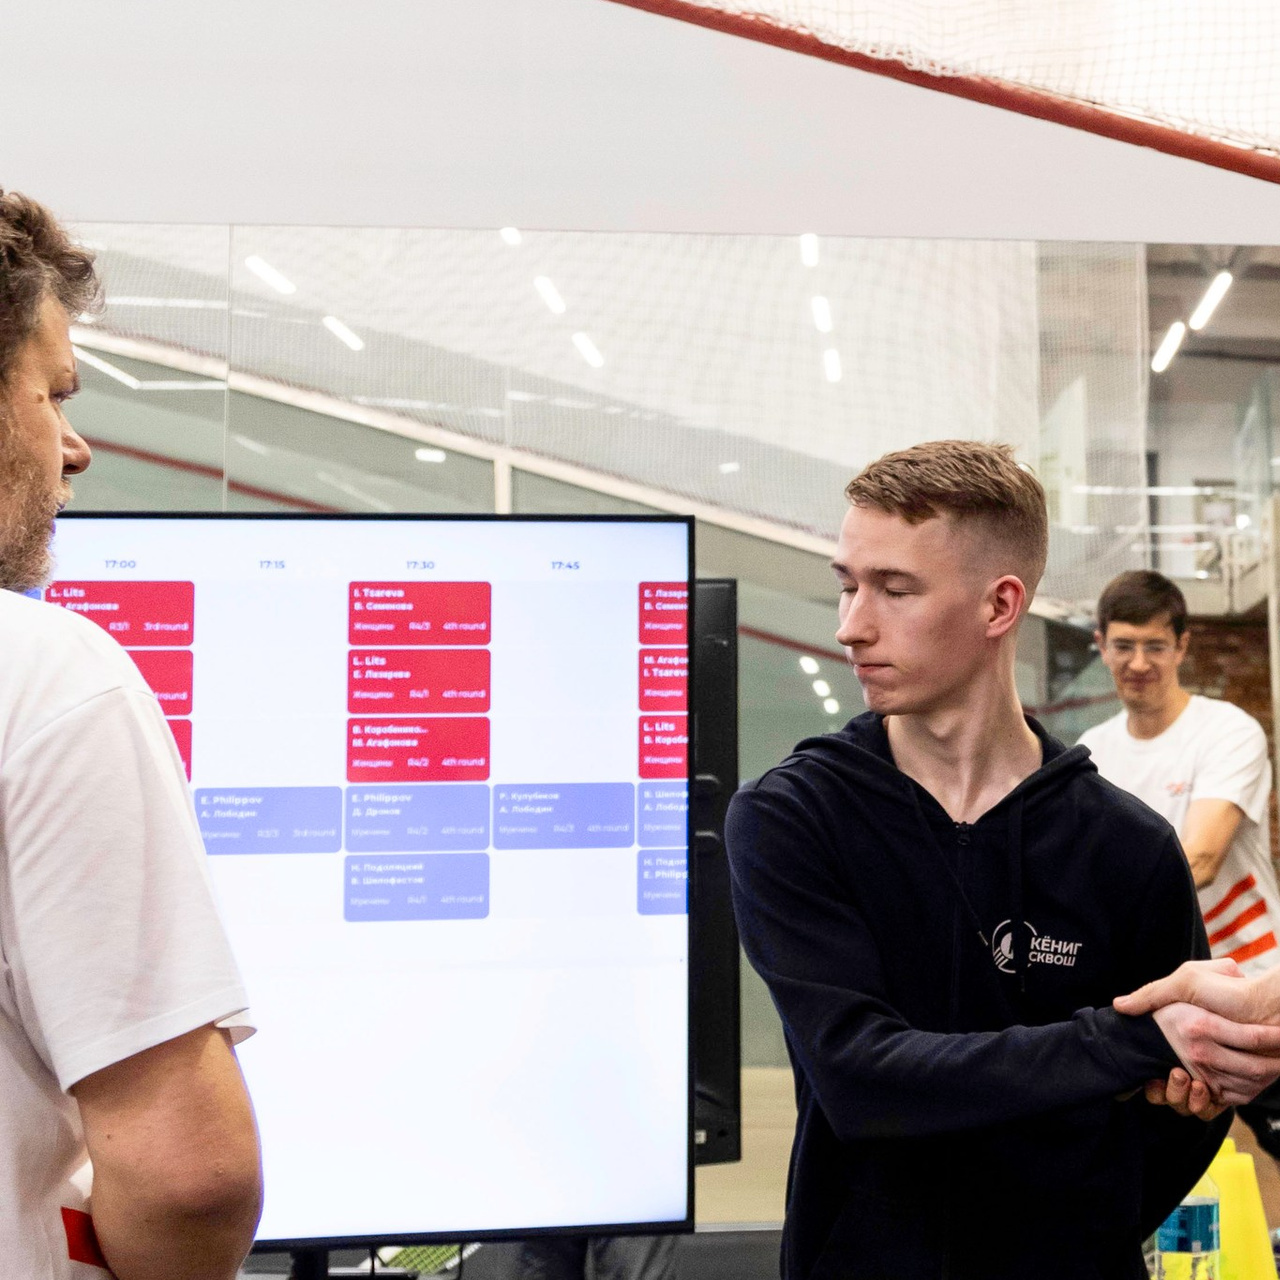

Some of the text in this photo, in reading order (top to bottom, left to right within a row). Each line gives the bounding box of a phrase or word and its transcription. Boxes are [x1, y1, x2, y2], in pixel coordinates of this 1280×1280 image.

[105, 560, 136, 569] 17:00
[260, 560, 285, 569] 17:15
[406, 561, 435, 570] 17:30
[551, 561, 580, 570] 17:45
[63, 588, 85, 597] Lits
[363, 588, 405, 597] Tsareva
[160, 623, 189, 631] round
[459, 622, 486, 630] round
[365, 657, 386, 665] Lits
[459, 690, 486, 698] round
[656, 722, 675, 731] Lits
[458, 758, 485, 766] round
[213, 795, 263, 806] Philippov
[364, 794, 413, 803] Philippov
[456, 826, 484, 834] round
[602, 824, 630, 832] round
[1030, 935, 1083, 955] КЁНИГ
[1028, 951, 1076, 967] СКВОШ
